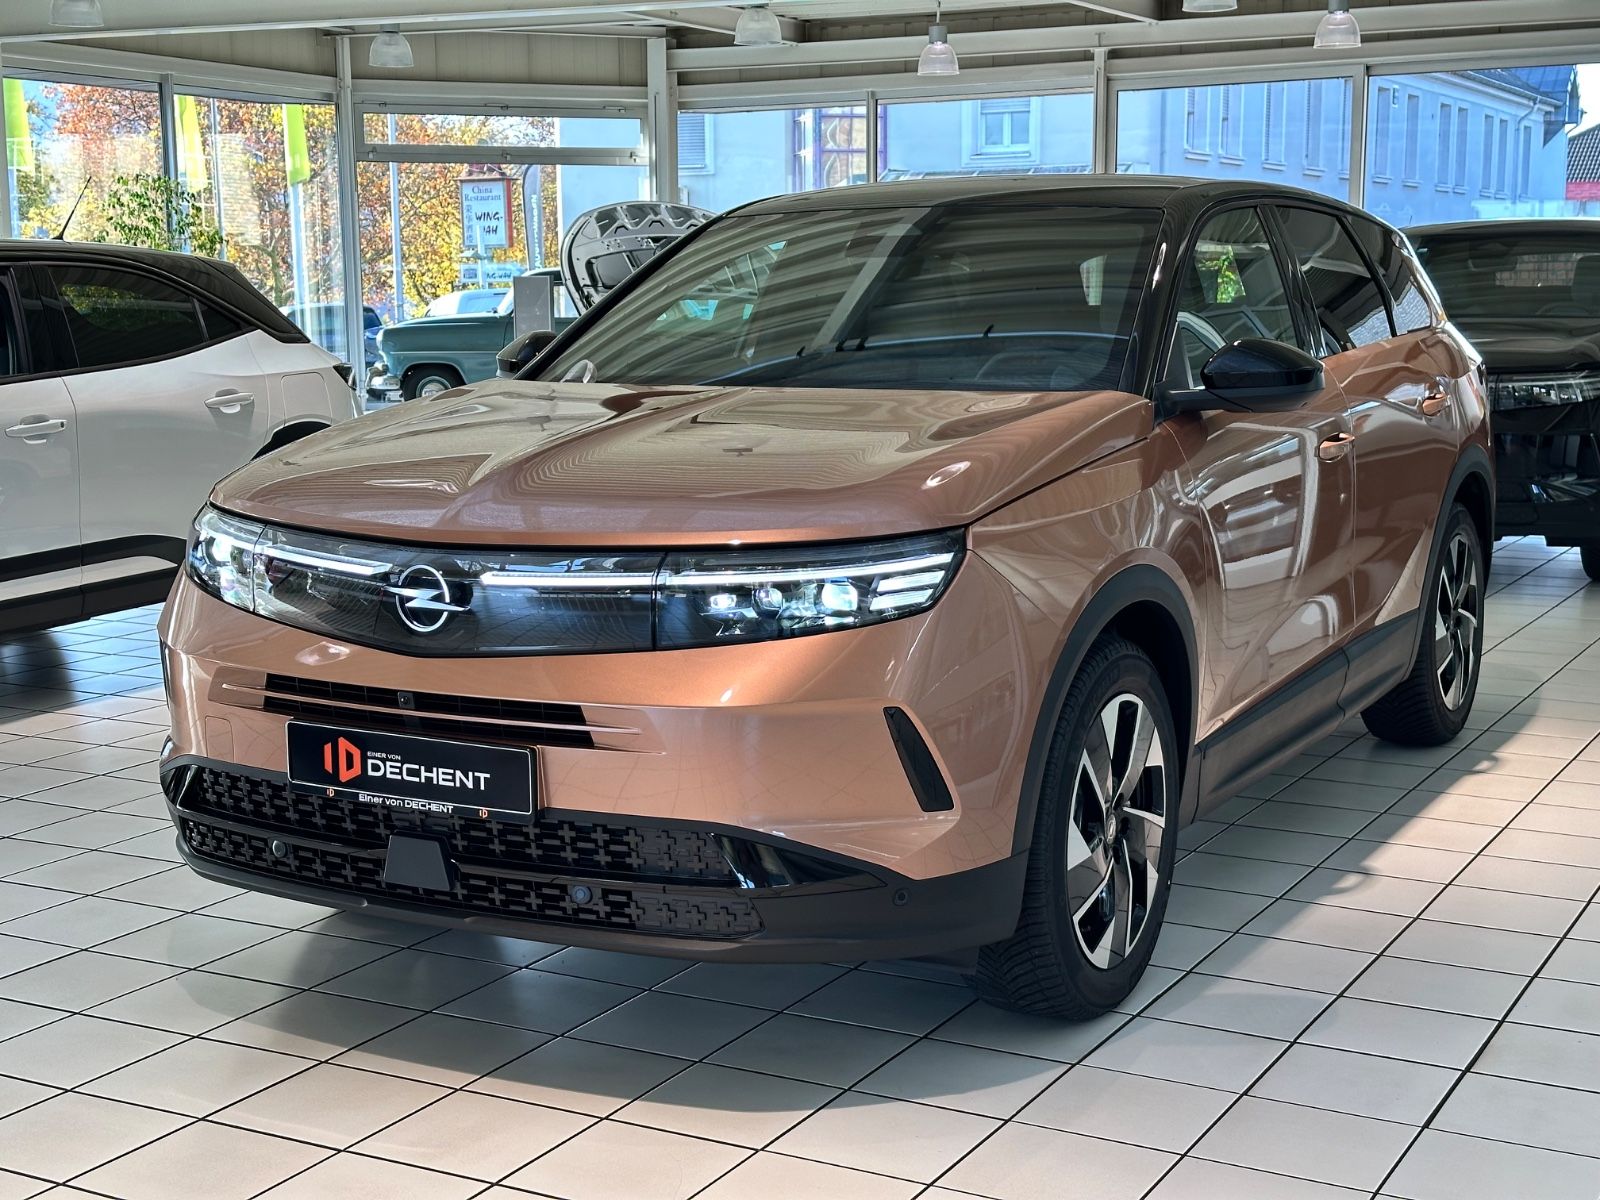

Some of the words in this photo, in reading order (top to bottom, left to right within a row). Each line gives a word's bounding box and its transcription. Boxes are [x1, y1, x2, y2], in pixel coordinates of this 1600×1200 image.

[472, 186, 492, 194] China
[464, 193, 501, 202] Restaurant
[367, 751, 386, 760] EINER
[387, 753, 401, 761] VON
[367, 758, 490, 790] DECHENT
[358, 793, 383, 804] Einer
[384, 797, 403, 807] von
[404, 800, 453, 814] DECHENT
